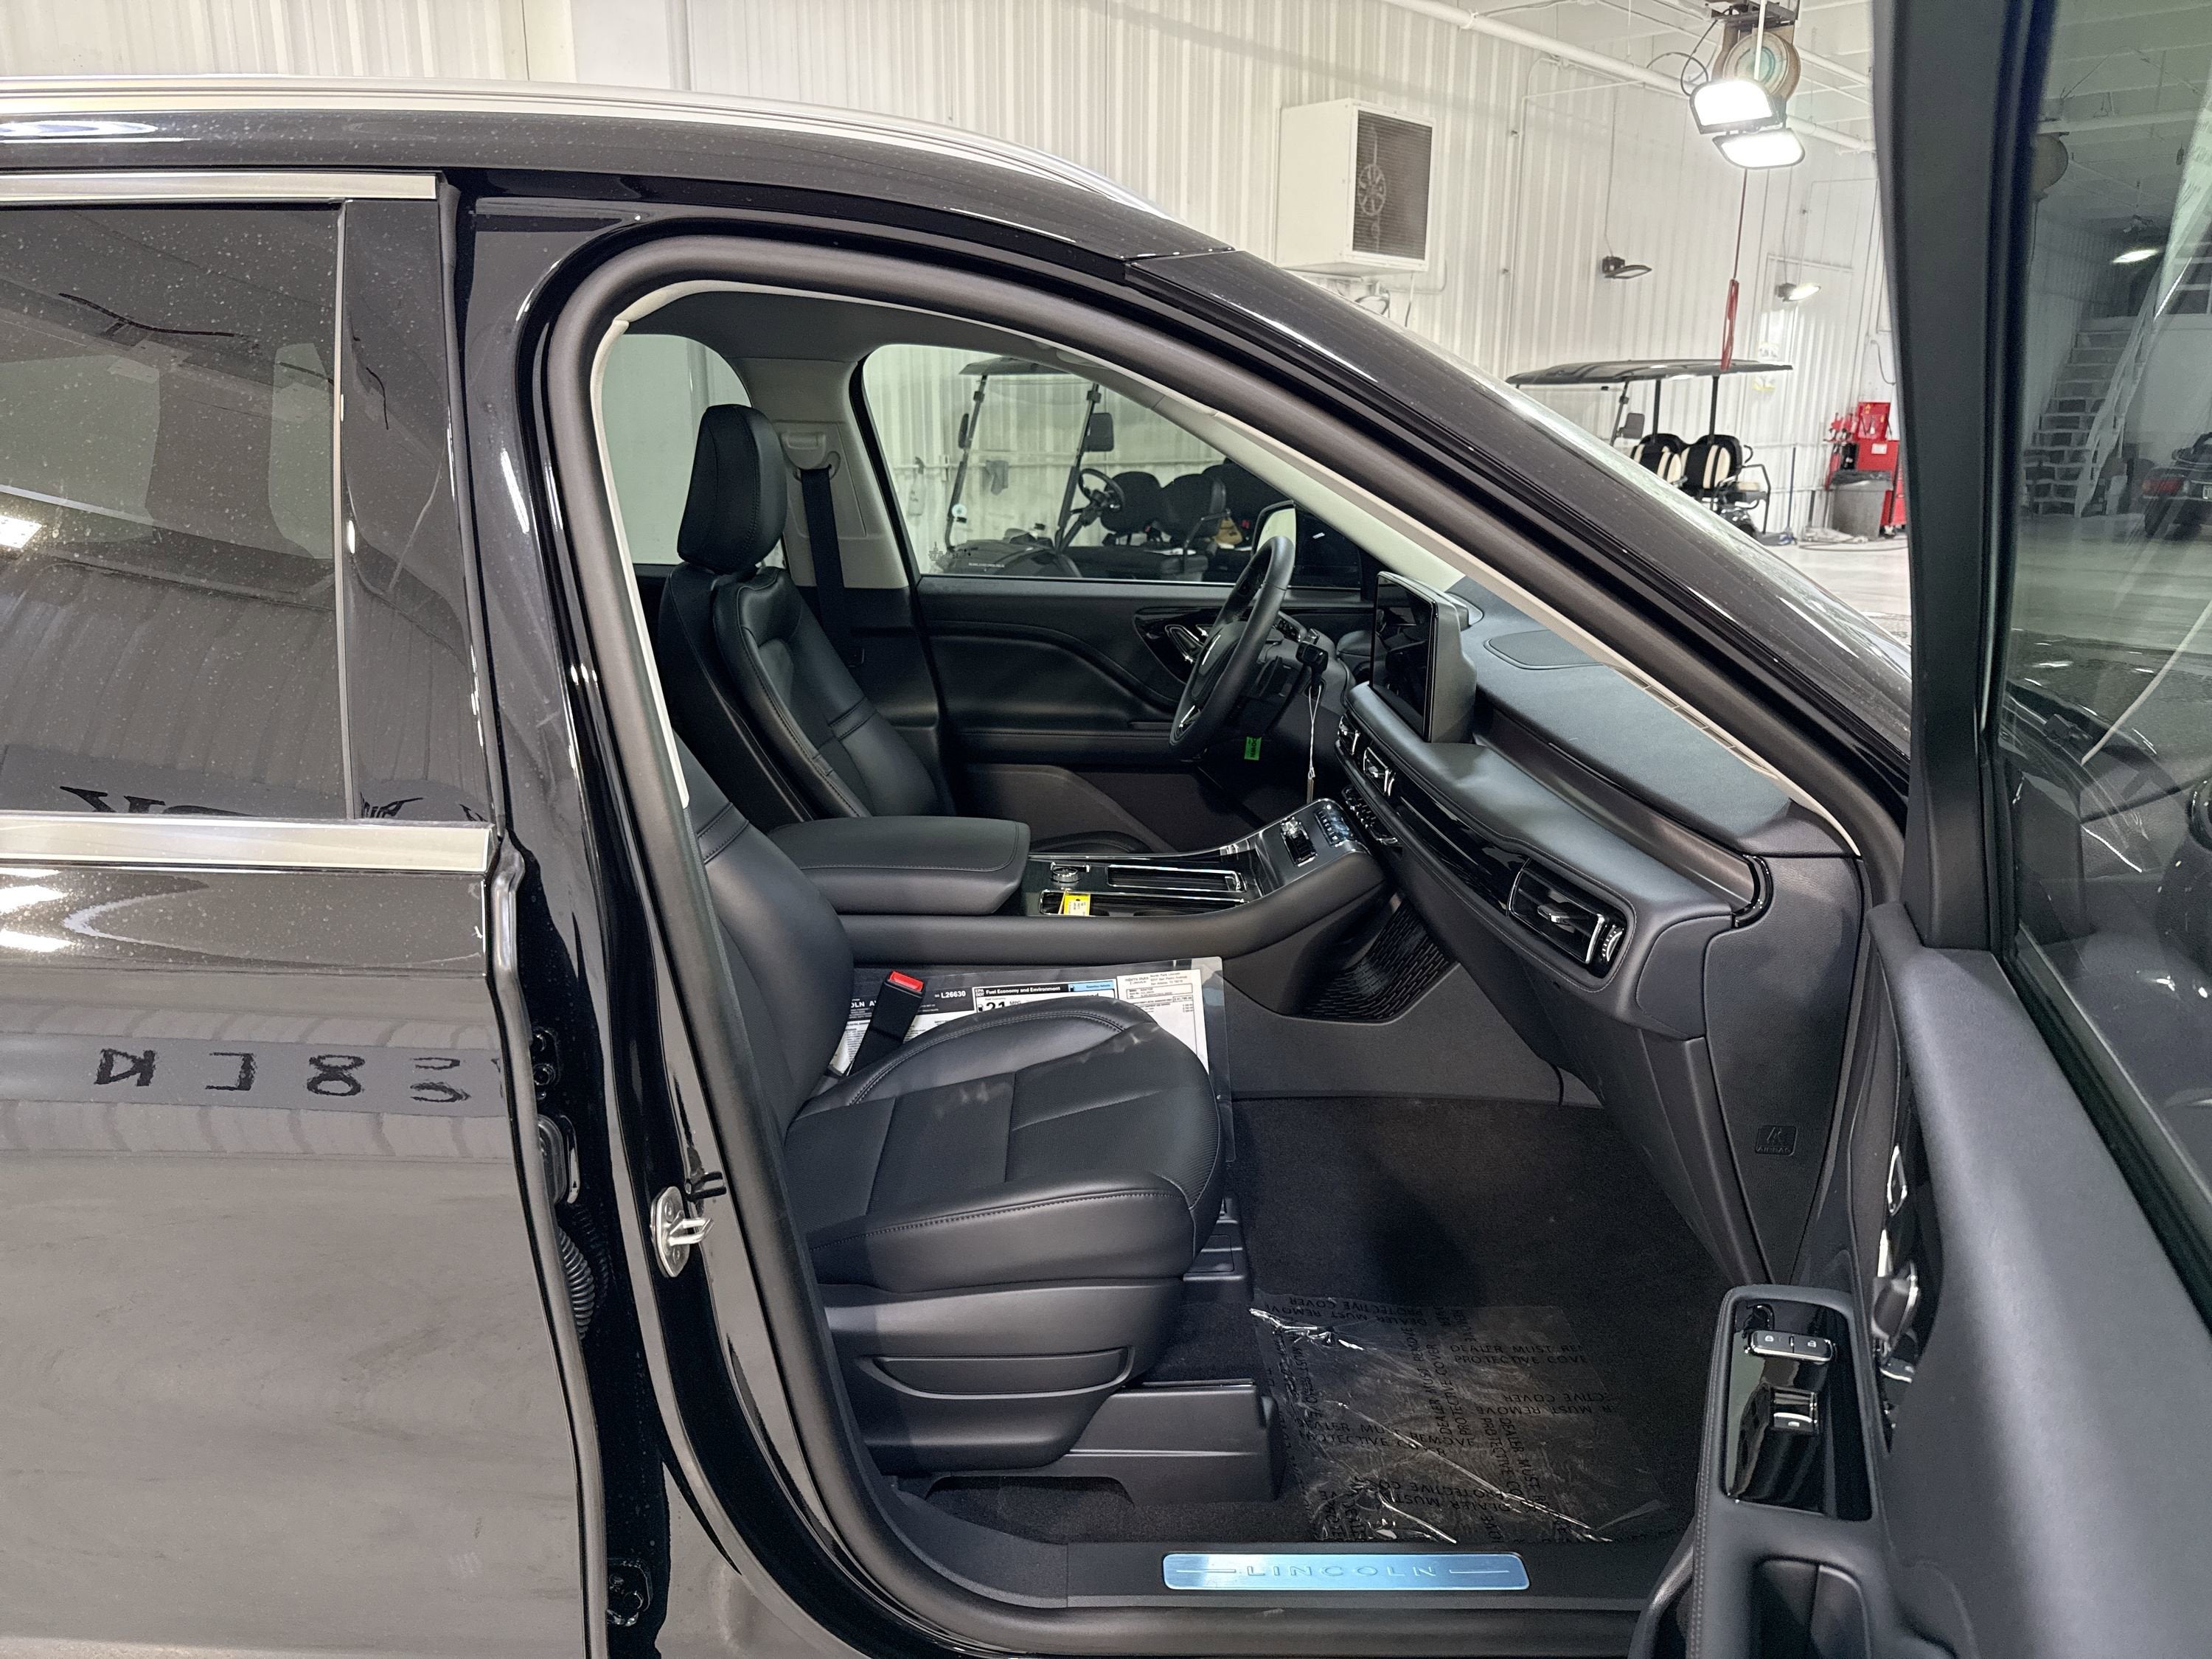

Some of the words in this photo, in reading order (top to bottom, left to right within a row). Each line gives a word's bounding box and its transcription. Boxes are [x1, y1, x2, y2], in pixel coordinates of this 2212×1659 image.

[941, 990, 967, 998] L26630
[1450, 1344, 1504, 1354] DEALER
[1512, 1345, 1553, 1354] MUST
[1427, 1343, 1448, 1376] COVER
[1455, 1354, 1540, 1365] PROTECTIVE
[1503, 1394, 1555, 1403] COVER
[1476, 1405, 1542, 1416] REMOVE
[1551, 1405, 1593, 1415] MUST
[1429, 1399, 1453, 1435] DEALER
[1360, 1423, 1402, 1436] MUT
[1499, 1417, 1524, 1453] DEALER
[1246, 1564, 1436, 1577] LINCOLN
